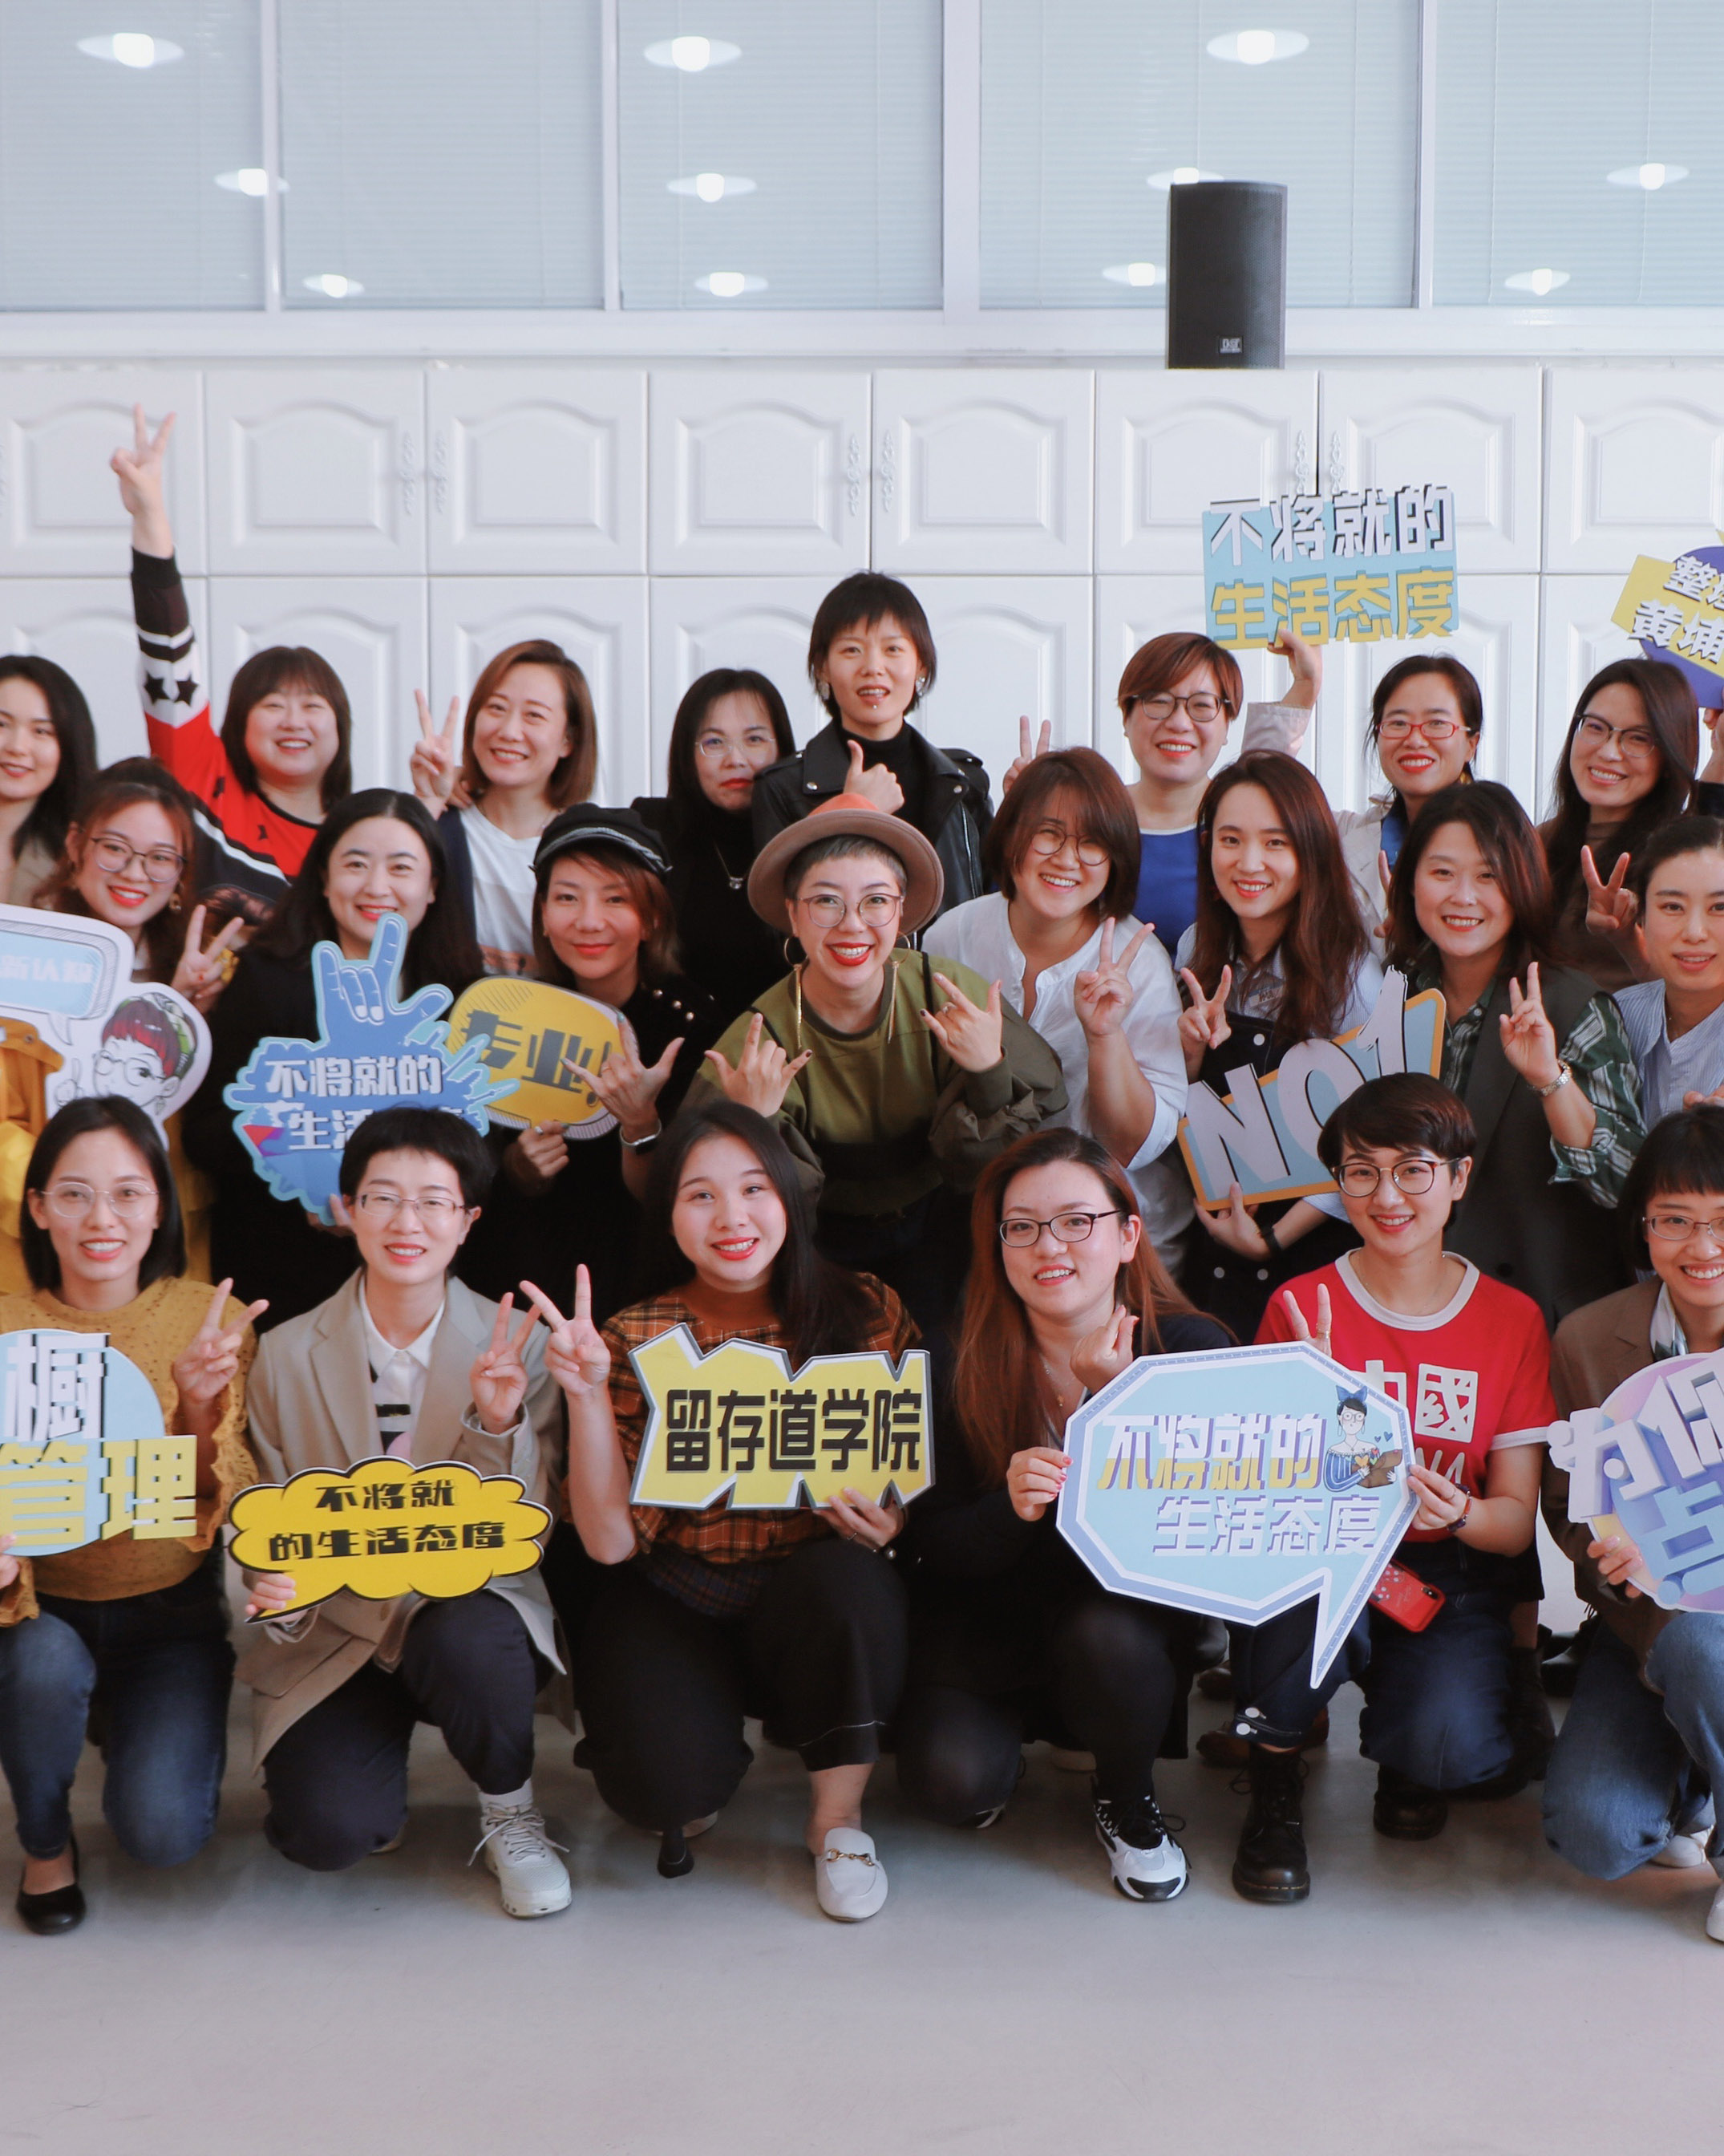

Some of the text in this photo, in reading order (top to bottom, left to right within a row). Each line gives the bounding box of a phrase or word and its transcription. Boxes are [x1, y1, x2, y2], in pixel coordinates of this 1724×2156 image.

[1209, 484, 1453, 565] 不将就的
[1211, 565, 1454, 649] 生活态度
[265, 1054, 443, 1098] 不将就的
[666, 1388, 922, 1473] 留存道学院
[1097, 1412, 1327, 1490] 不将就的
[315, 1479, 455, 1512] 不将就
[1153, 1494, 1382, 1557] 生活态度
[268, 1522, 506, 1562] 的生活态度
